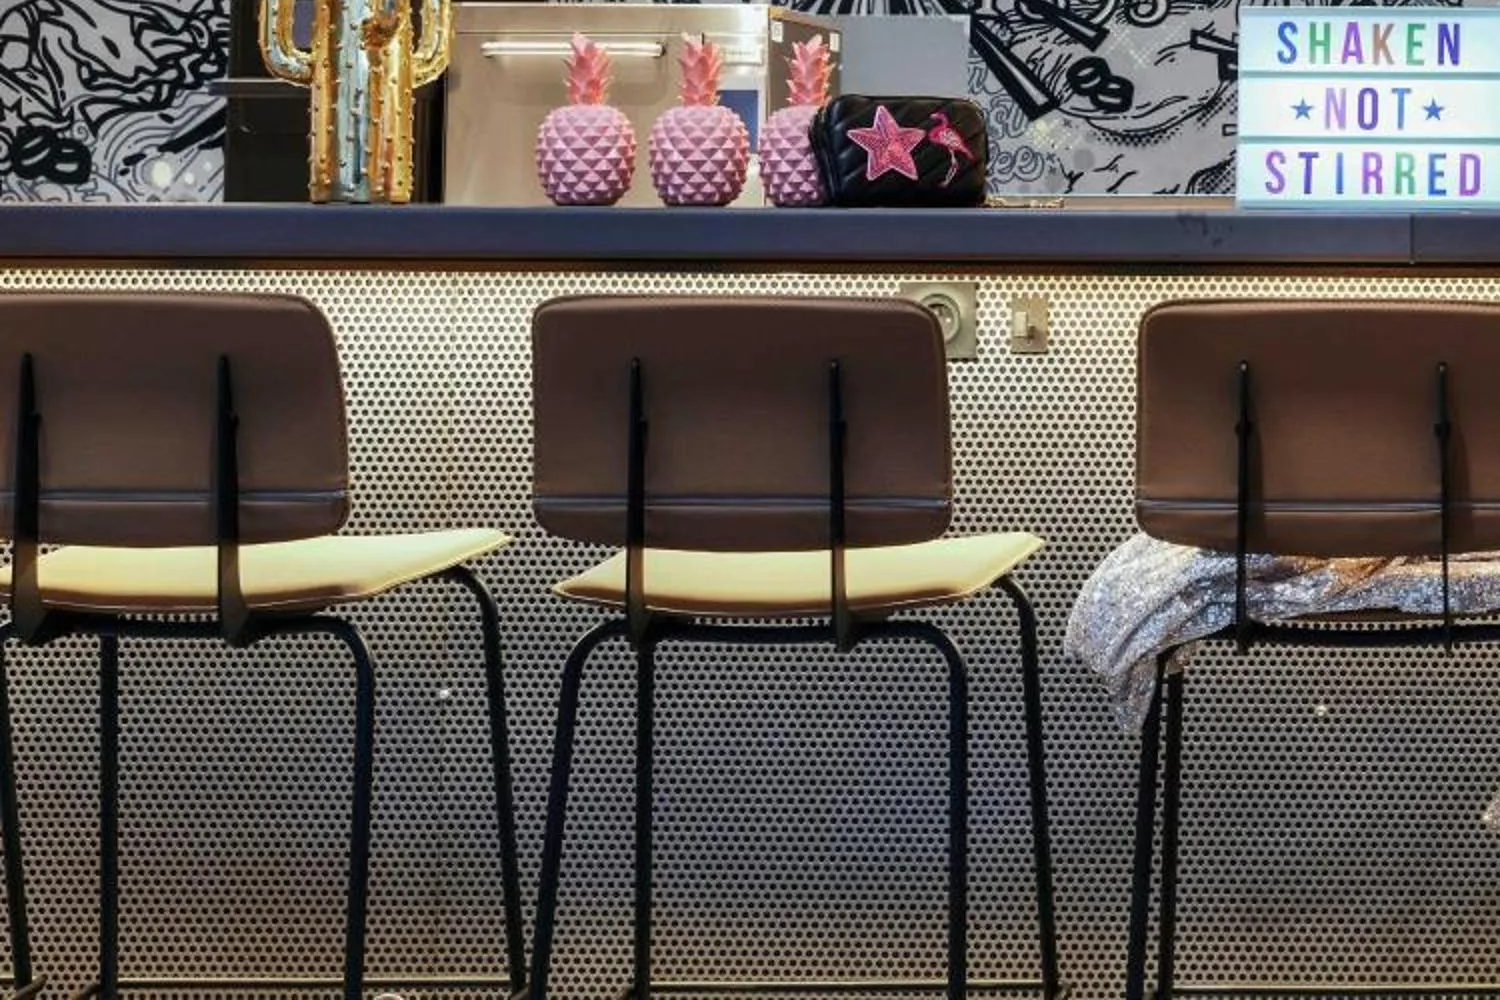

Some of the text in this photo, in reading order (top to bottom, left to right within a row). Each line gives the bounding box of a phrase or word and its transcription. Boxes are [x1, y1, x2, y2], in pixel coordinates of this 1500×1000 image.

[1276, 21, 1461, 66] SHAKEN
[1324, 87, 1413, 131] NOT
[1265, 150, 1482, 196] STIRRED
